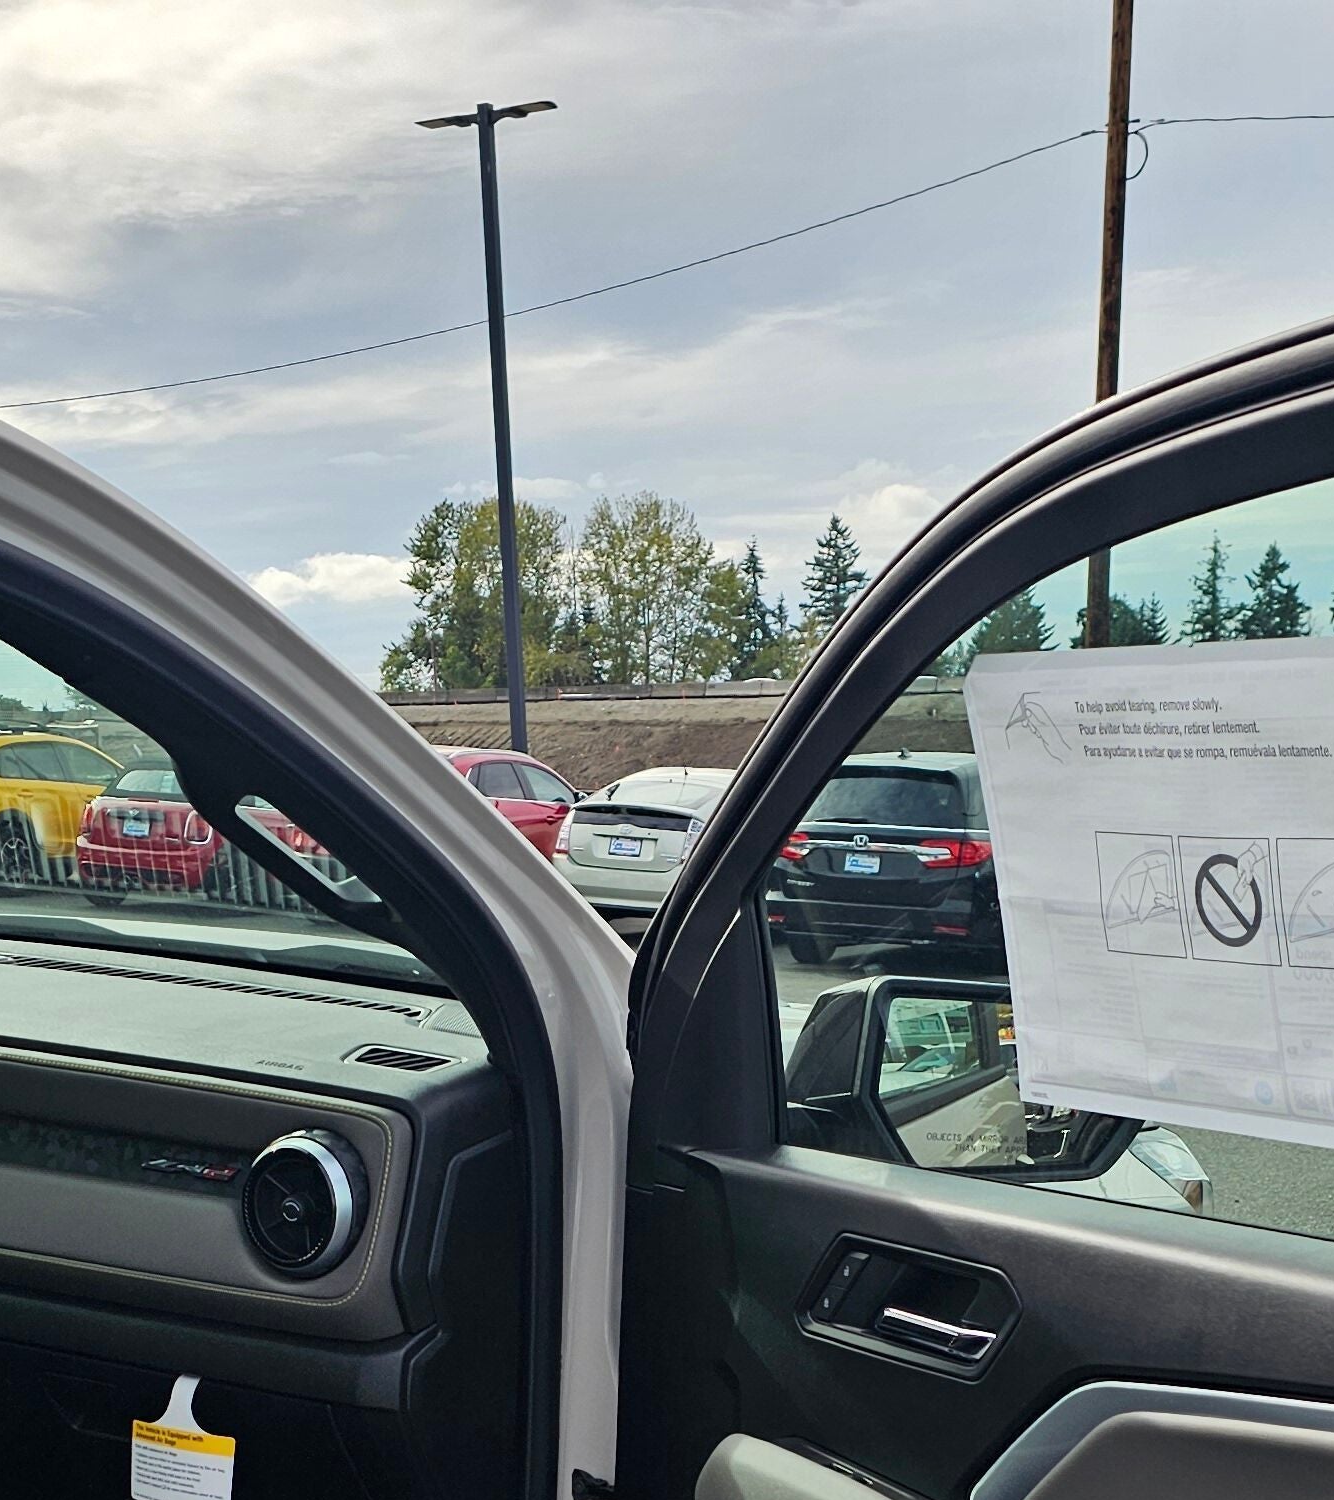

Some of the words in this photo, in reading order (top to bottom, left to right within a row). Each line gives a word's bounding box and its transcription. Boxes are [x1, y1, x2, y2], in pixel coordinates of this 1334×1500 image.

[1075, 701, 1085, 714] To
[1086, 701, 1103, 715] help
[1105, 700, 1126, 712] avoid
[1128, 699, 1156, 714] tearing,
[1159, 699, 1190, 711] remove
[1192, 697, 1222, 712] slowly.
[1079, 723, 1096, 735] Pour
[1098, 722, 1121, 735] éviter
[1122, 722, 1142, 735] toute
[1143, 721, 1183, 736] déchirure,
[1184, 722, 1210, 734] retirer
[1212, 720, 1260, 733] lentement.
[1084, 745, 1101, 757] Para
[1137, 748, 1143, 758] a
[1145, 746, 1165, 758] evitar
[1167, 748, 1181, 760] que
[1184, 748, 1194, 759] se
[1196, 747, 1227, 760] rompa,
[1230, 744, 1277, 758] remuévala
[1278, 744, 1333, 758] lentamente.
[256, 1059, 305, 1071] AIRBAG
[926, 1132, 962, 1142] OBJECTS
[966, 1134, 974, 1142] IN
[978, 1134, 1009, 1143] MIRROR
[954, 1144, 976, 1152] THAN
[980, 1144, 1001, 1153] THEY
